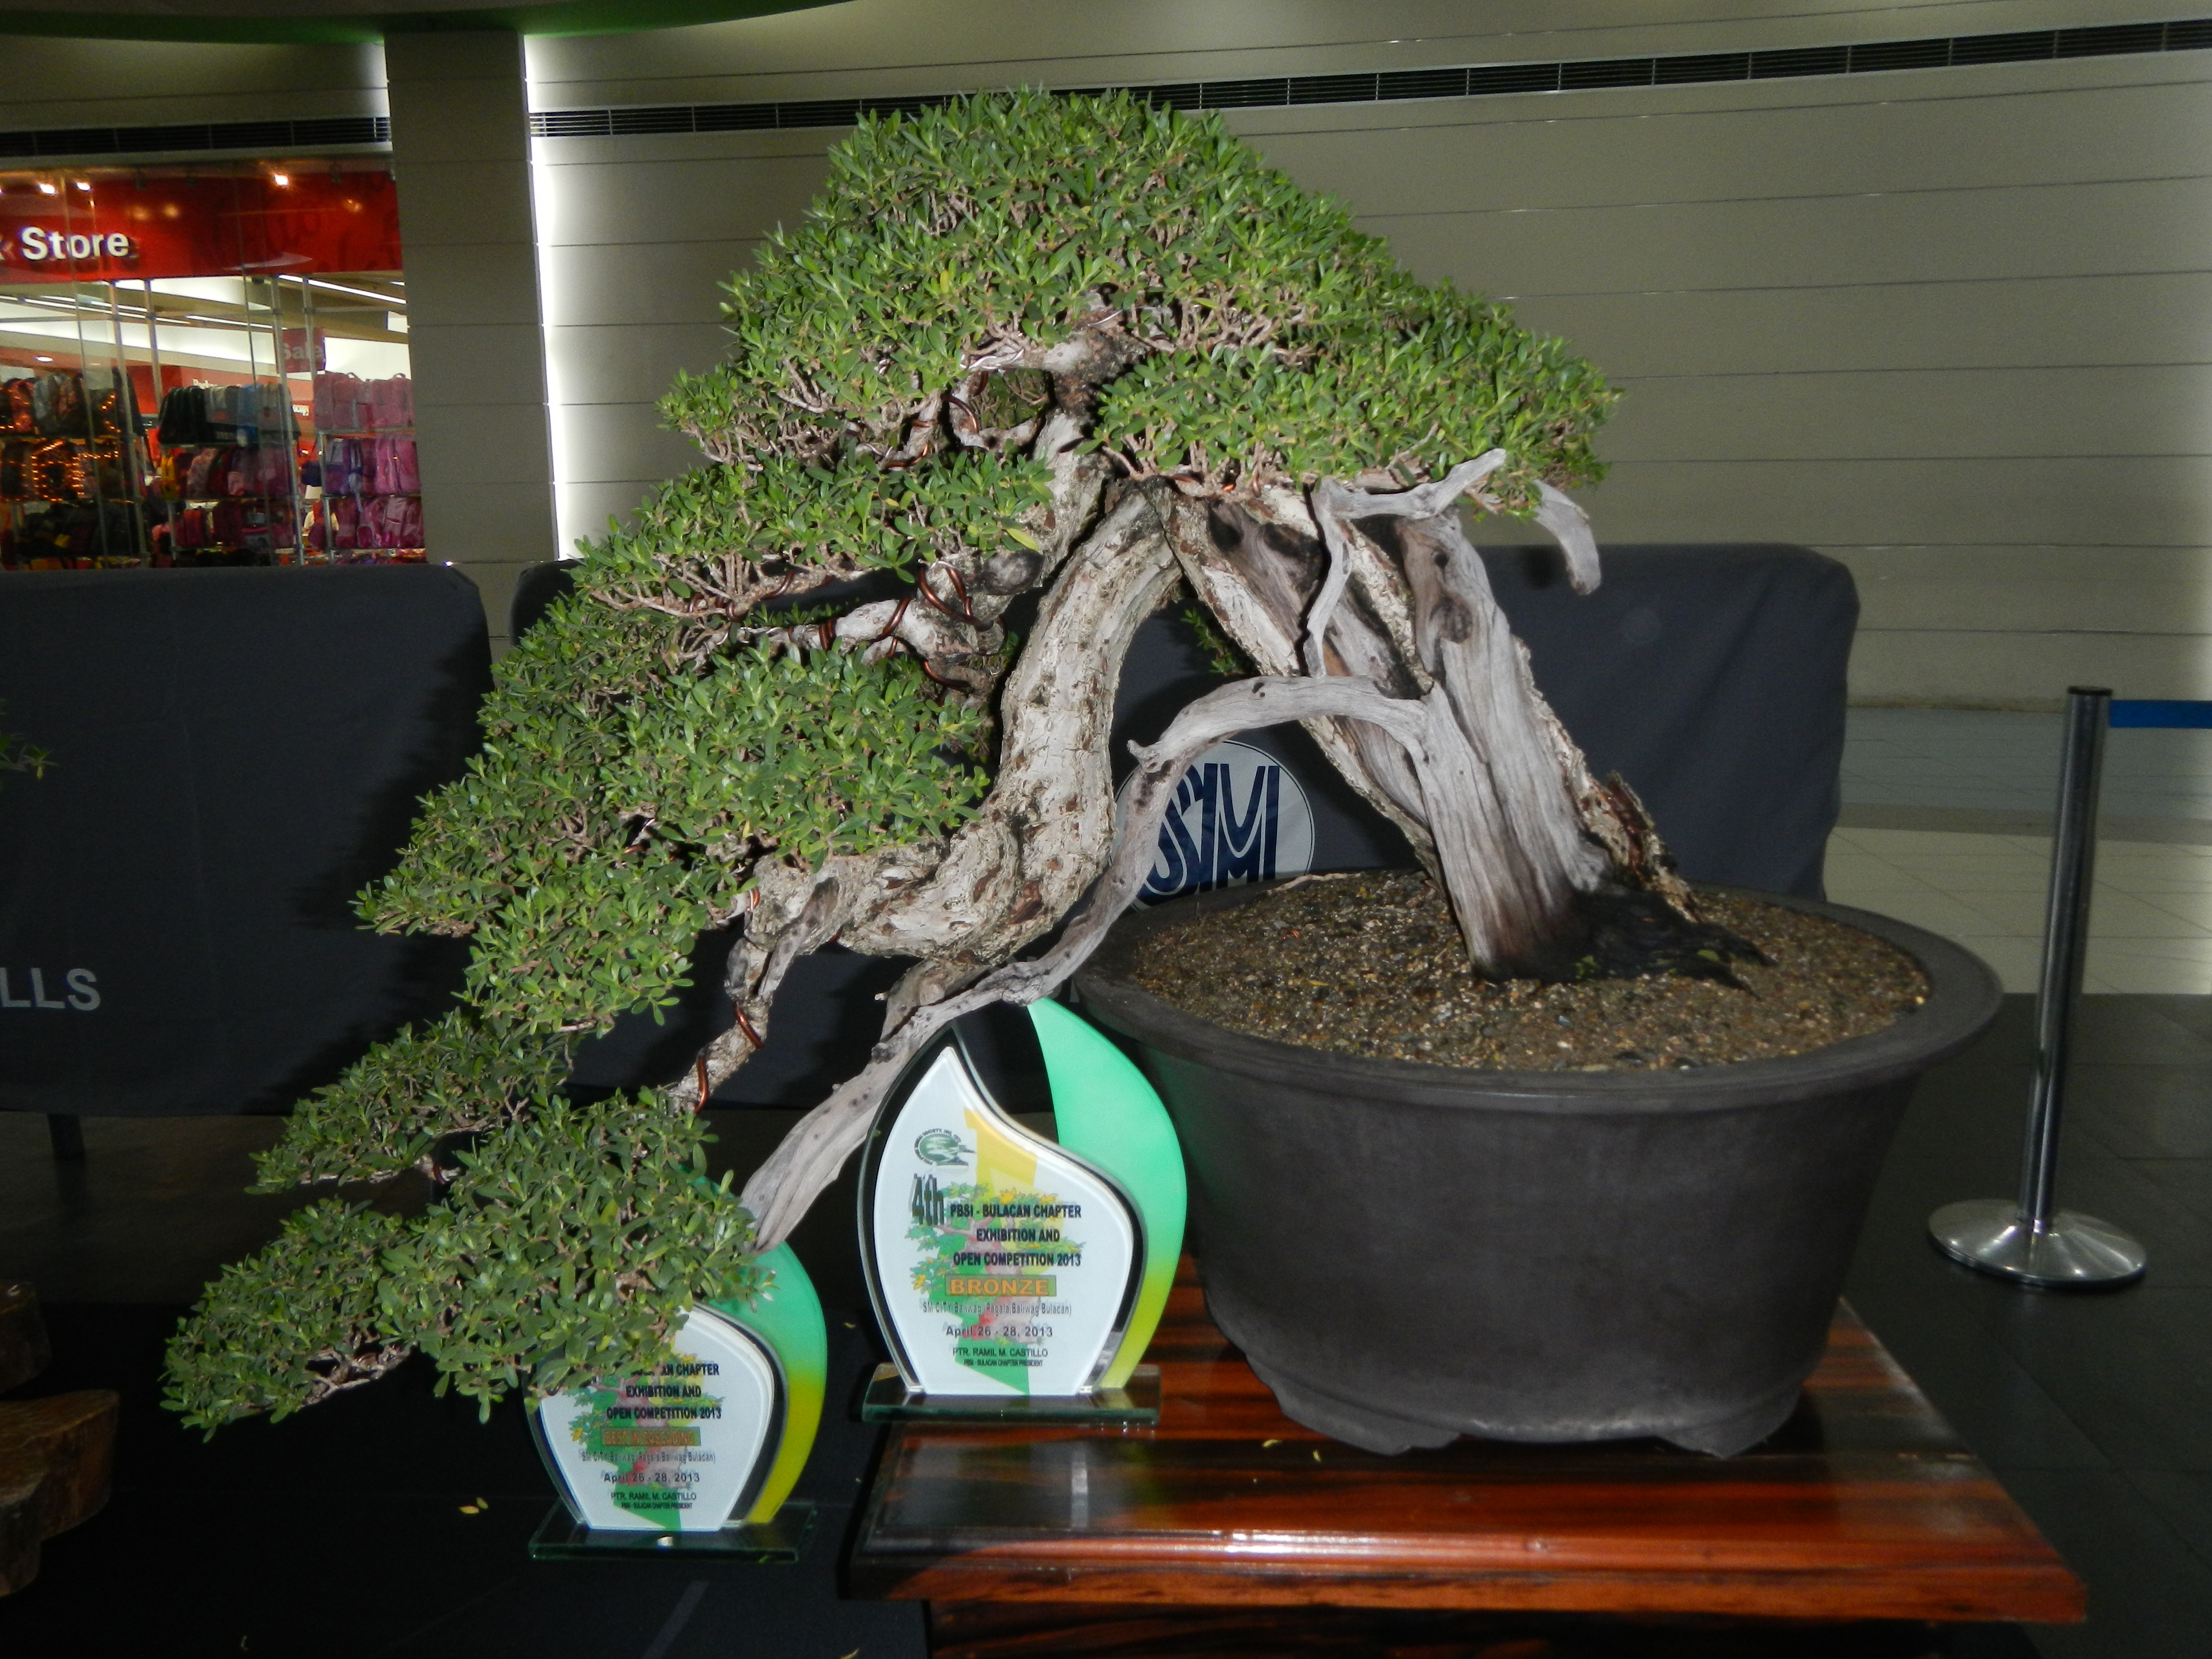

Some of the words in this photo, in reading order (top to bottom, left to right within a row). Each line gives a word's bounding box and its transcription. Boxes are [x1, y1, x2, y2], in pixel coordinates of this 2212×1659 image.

[21, 226, 130, 260] Store
[1136, 762, 1280, 907] SM
[910, 1174, 944, 1225] 4th
[950, 1203, 974, 1217] PBSI
[983, 1203, 1031, 1218] BULACAN
[1034, 1204, 1082, 1218] CHAPTER
[976, 1228, 1036, 1242] EXHIBITION
[1039, 1228, 1060, 1242] AND
[953, 1252, 981, 1266] OPEN
[984, 1251, 1054, 1266] COMPETITION
[1057, 1252, 1082, 1266] 2013
[950, 1279, 1049, 1295] BRONZE
[936, 1302, 951, 1312] CITY
[946, 1326, 973, 1339] April
[978, 1326, 991, 1336] 26
[1003, 1326, 1020, 1337] 28,
[1024, 1326, 1053, 1337] 2013
[973, 1348, 997, 1357] RAMIL
[1010, 1348, 1048, 1357] CASTILLO
[676, 1363, 720, 1376] CHAPTER
[626, 1385, 680, 1397] EXHIBITION
[682, 1385, 701, 1398] AND
[606, 1407, 632, 1419] OPEN
[634, 1407, 697, 1419] COMPETITION
[699, 1407, 721, 1419] 2013
[604, 1473, 628, 1484] April
[633, 1473, 644, 1482] 26
[674, 1473, 700, 1482] 2013
[662, 1492, 697, 1501] CASTILLO
